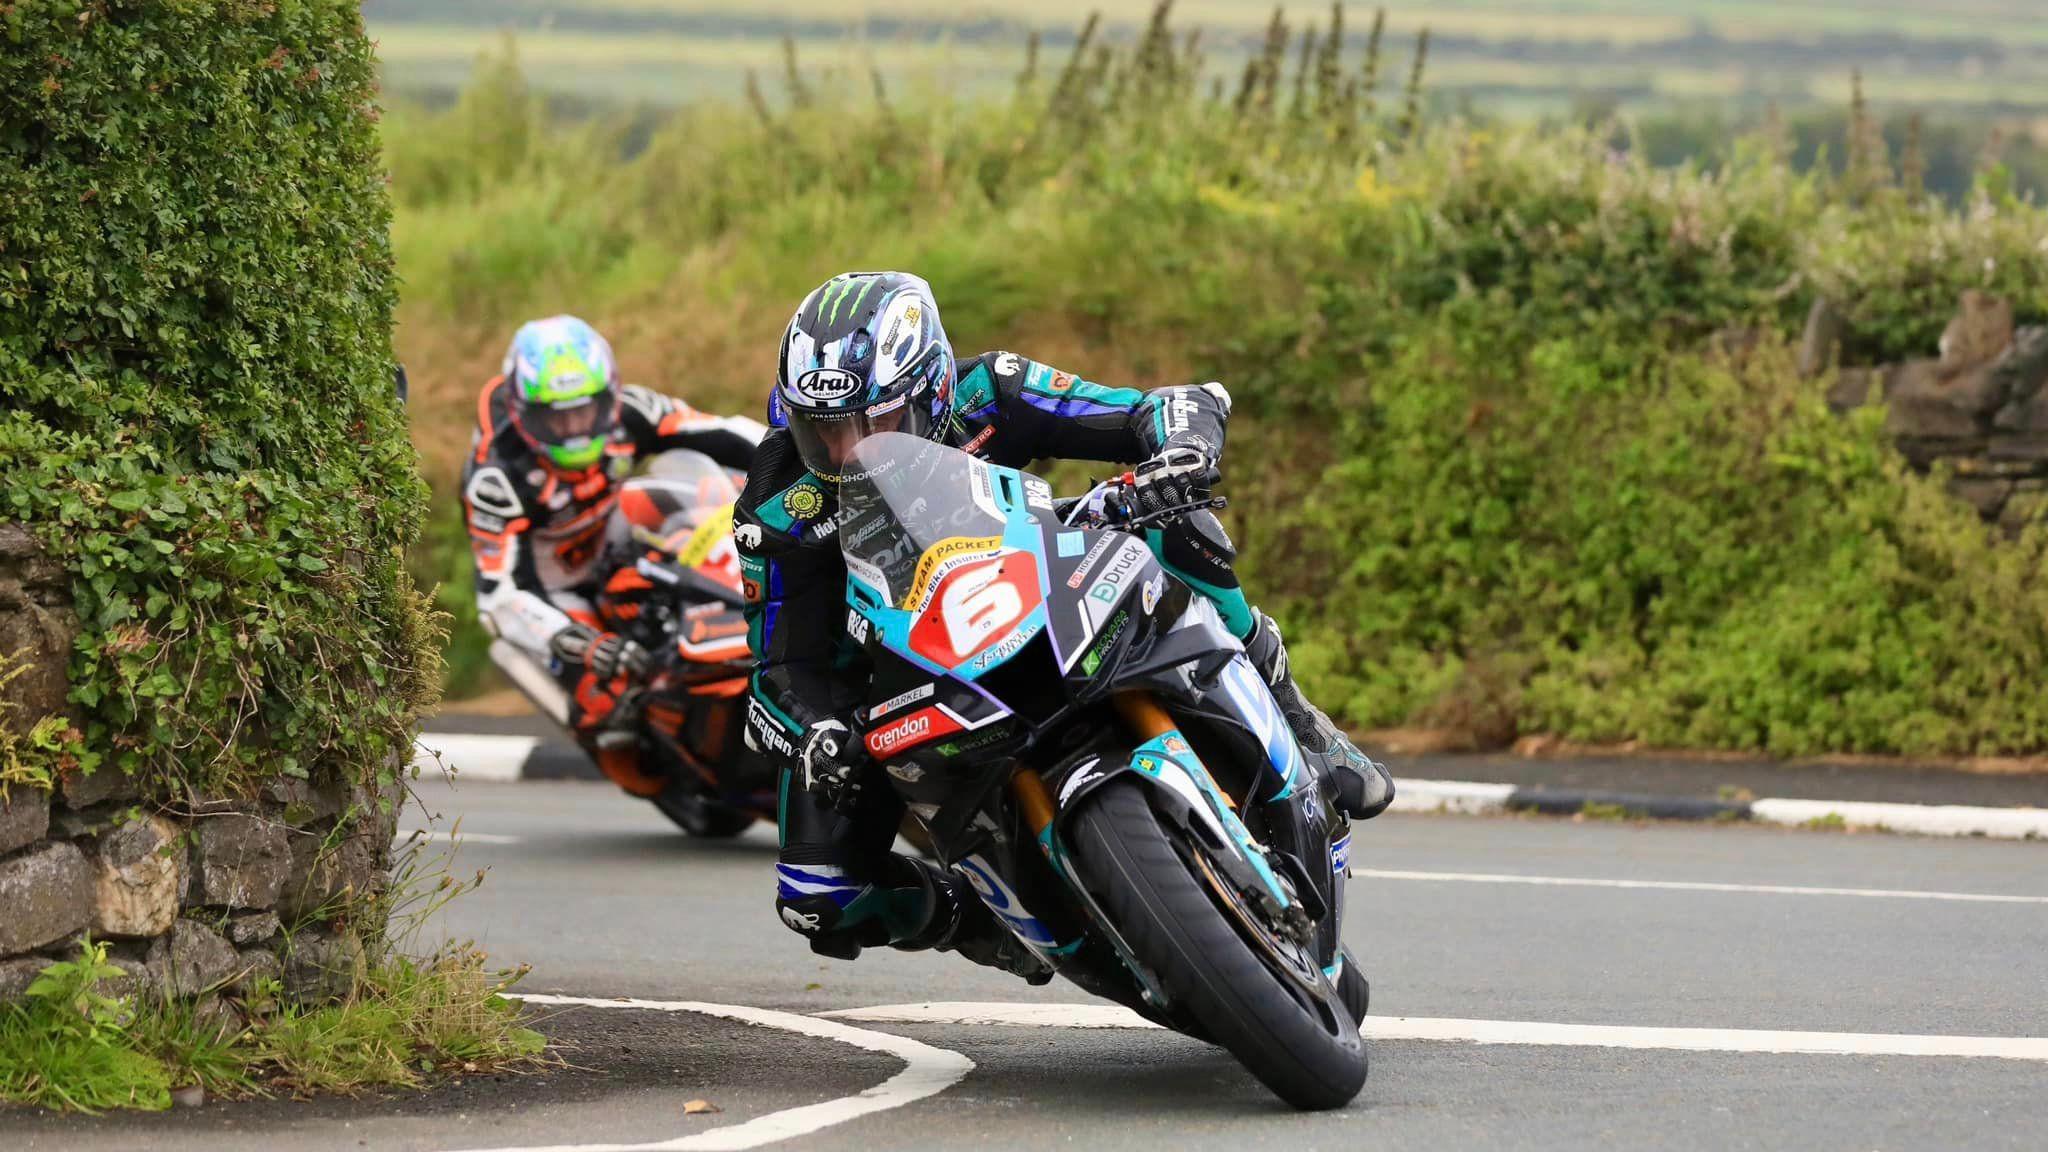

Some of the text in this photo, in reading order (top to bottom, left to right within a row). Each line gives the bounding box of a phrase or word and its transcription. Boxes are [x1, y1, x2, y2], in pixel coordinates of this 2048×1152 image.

[800, 372, 851, 392] Arai
[810, 411, 857, 420] PARAMOUNT
[1024, 480, 1053, 511] R&G
[910, 556, 935, 607] STEAM
[936, 539, 996, 558] PACKET
[928, 569, 945, 593] Bike
[944, 552, 985, 570] Insurer
[1104, 544, 1143, 584] Druck
[847, 608, 869, 646] R&G
[941, 558, 1023, 659] 6
[1098, 616, 1129, 660] PROJECTS
[885, 688, 925, 711] MARKEL
[749, 695, 794, 757] furygan
[870, 715, 930, 751] Crendon
